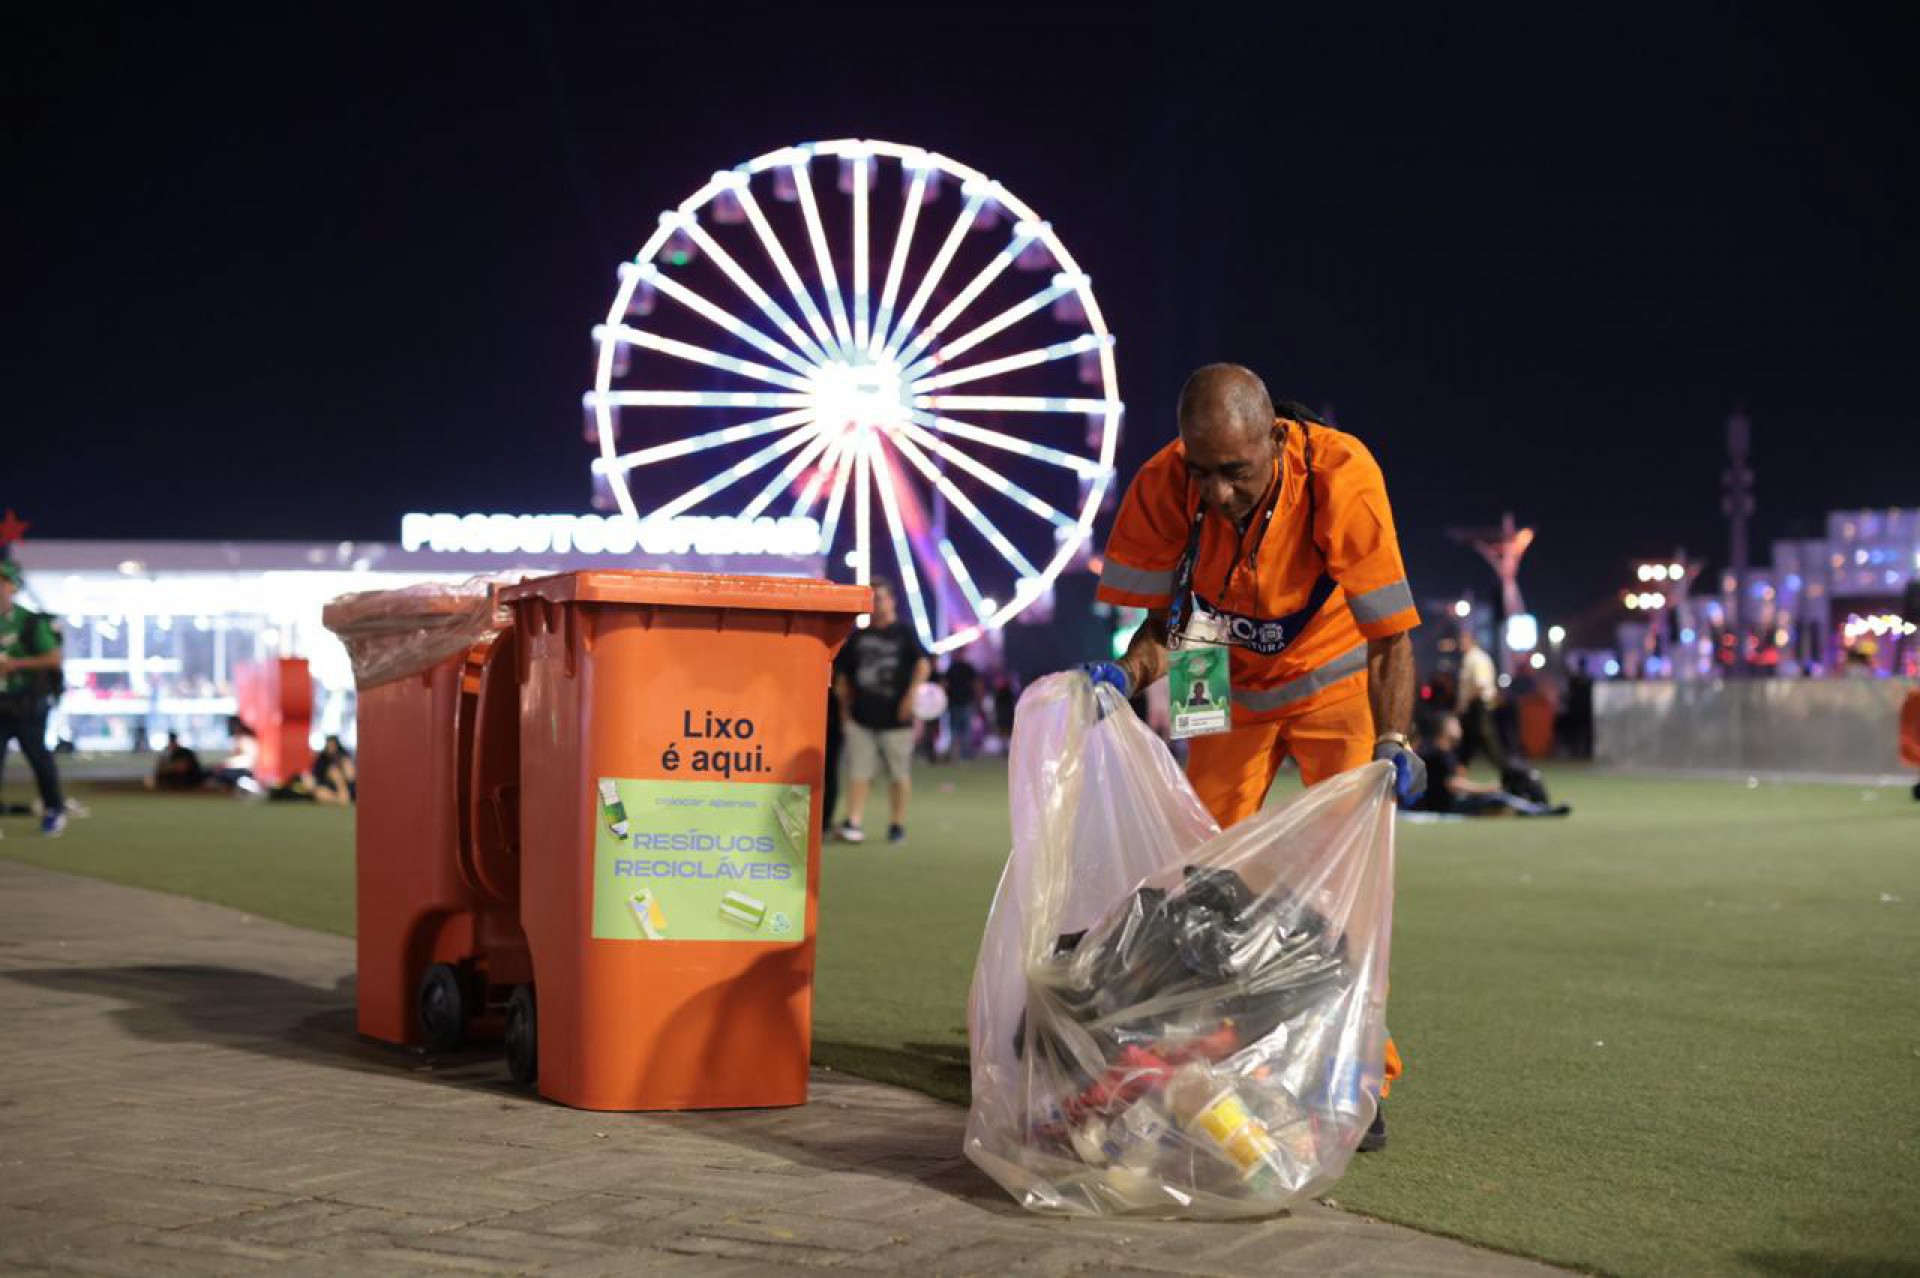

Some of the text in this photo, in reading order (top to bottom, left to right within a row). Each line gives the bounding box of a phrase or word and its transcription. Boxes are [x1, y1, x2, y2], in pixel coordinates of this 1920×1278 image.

[683, 710, 754, 739] Lixo
[661, 743, 772, 778] é aqui.
[633, 829, 775, 852] RESÍDUOS
[614, 857, 792, 880] RECICLÁVEIS
